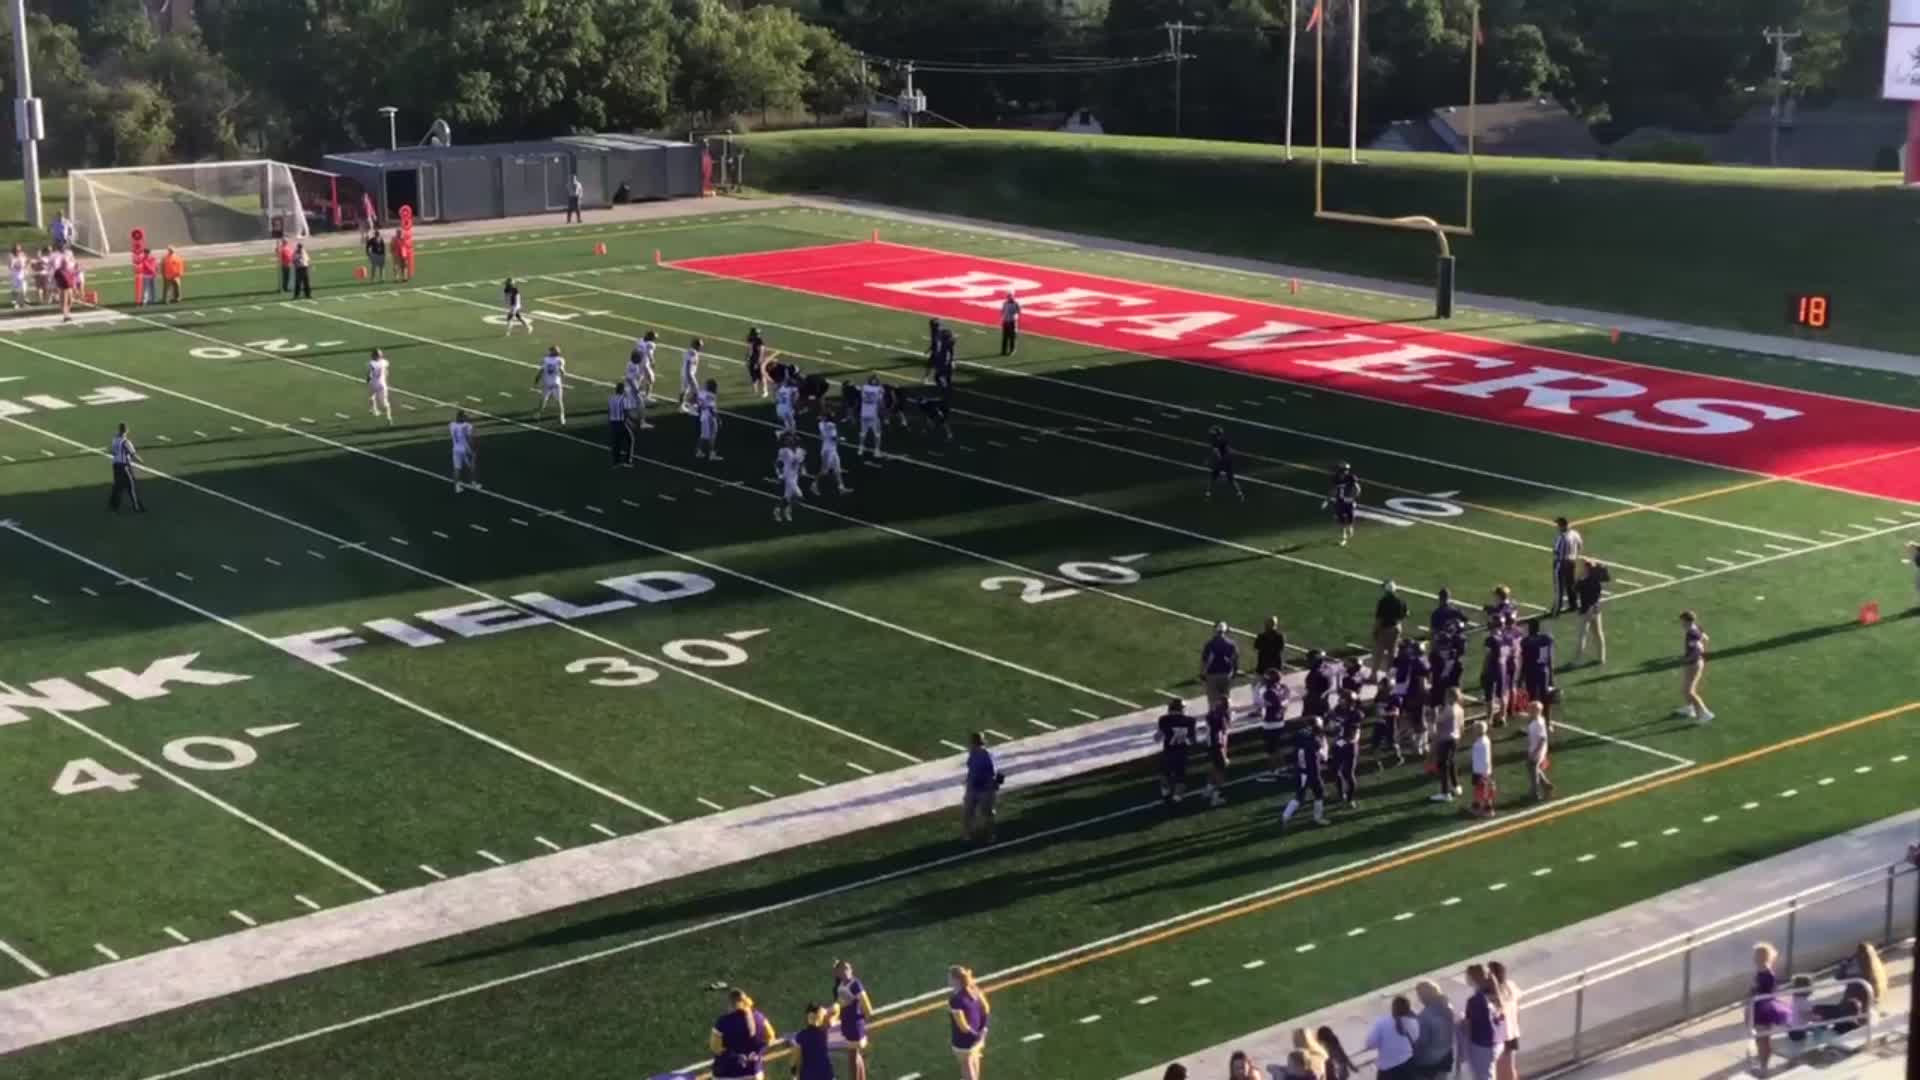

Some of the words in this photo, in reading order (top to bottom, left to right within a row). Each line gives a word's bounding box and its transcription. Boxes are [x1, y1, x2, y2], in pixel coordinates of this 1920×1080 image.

[1799, 296, 1826, 327] 18
[864, 271, 1804, 435] BEAVERS
[980, 561, 1141, 604] 20
[268, 570, 716, 667] FIELD
[565, 638, 749, 687] 30
[51, 735, 258, 796] 40
